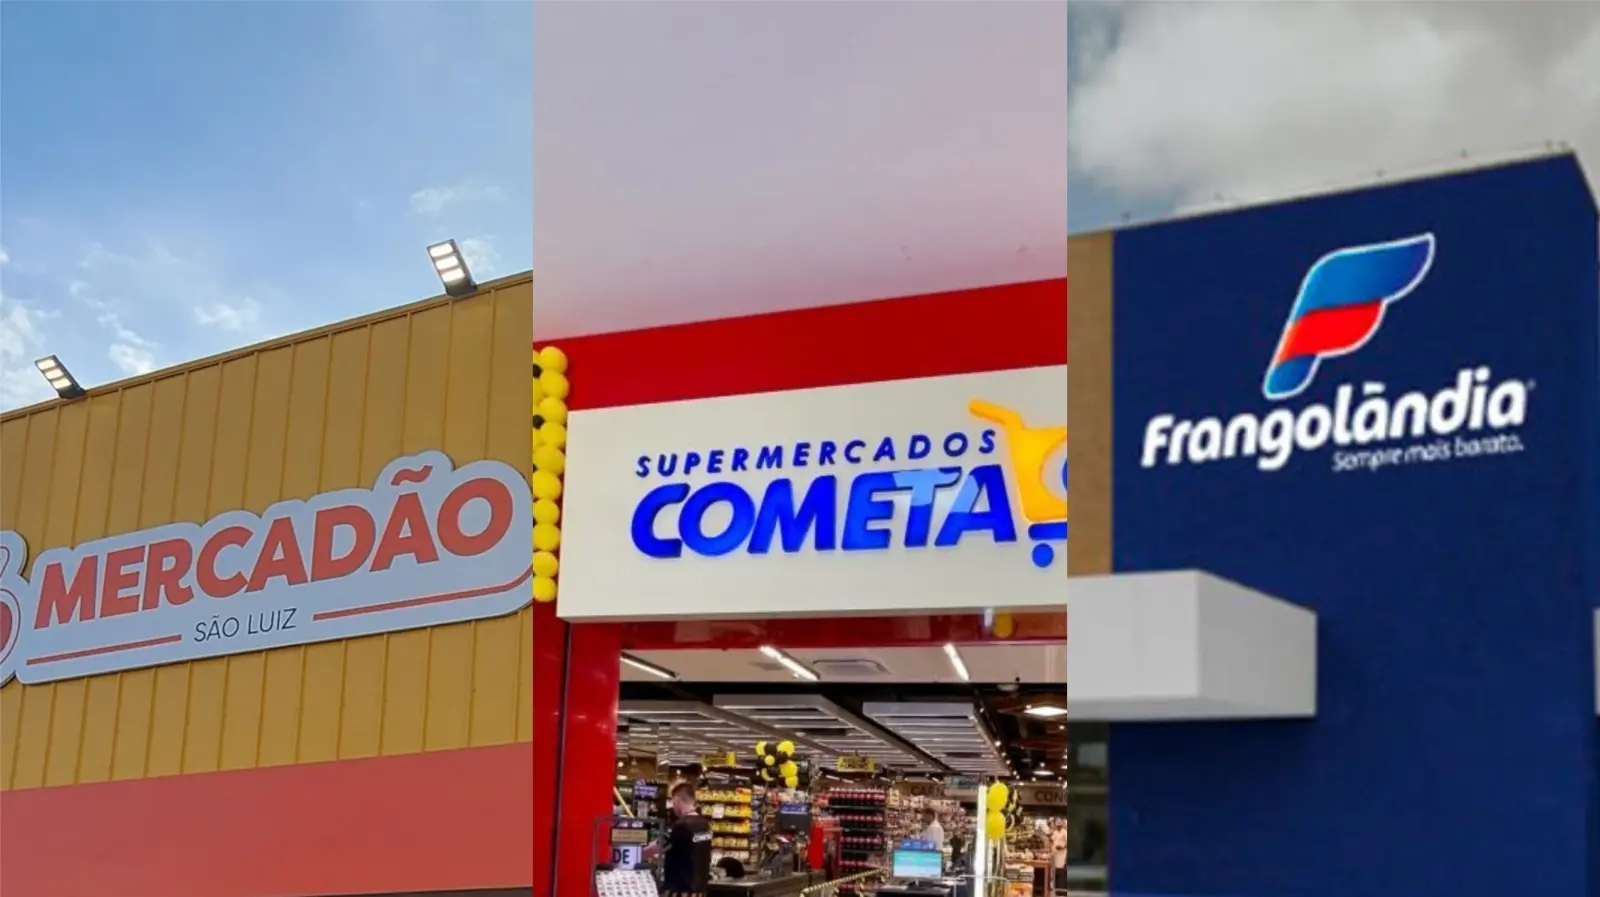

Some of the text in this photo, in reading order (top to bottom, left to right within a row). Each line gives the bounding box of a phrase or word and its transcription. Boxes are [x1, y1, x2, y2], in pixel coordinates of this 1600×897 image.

[636, 429, 996, 477] SUPERMERCADOS
[34, 465, 514, 628] MERCADÃO
[631, 464, 1017, 558] COMETA
[193, 607, 298, 642] SÃO LUIZ
